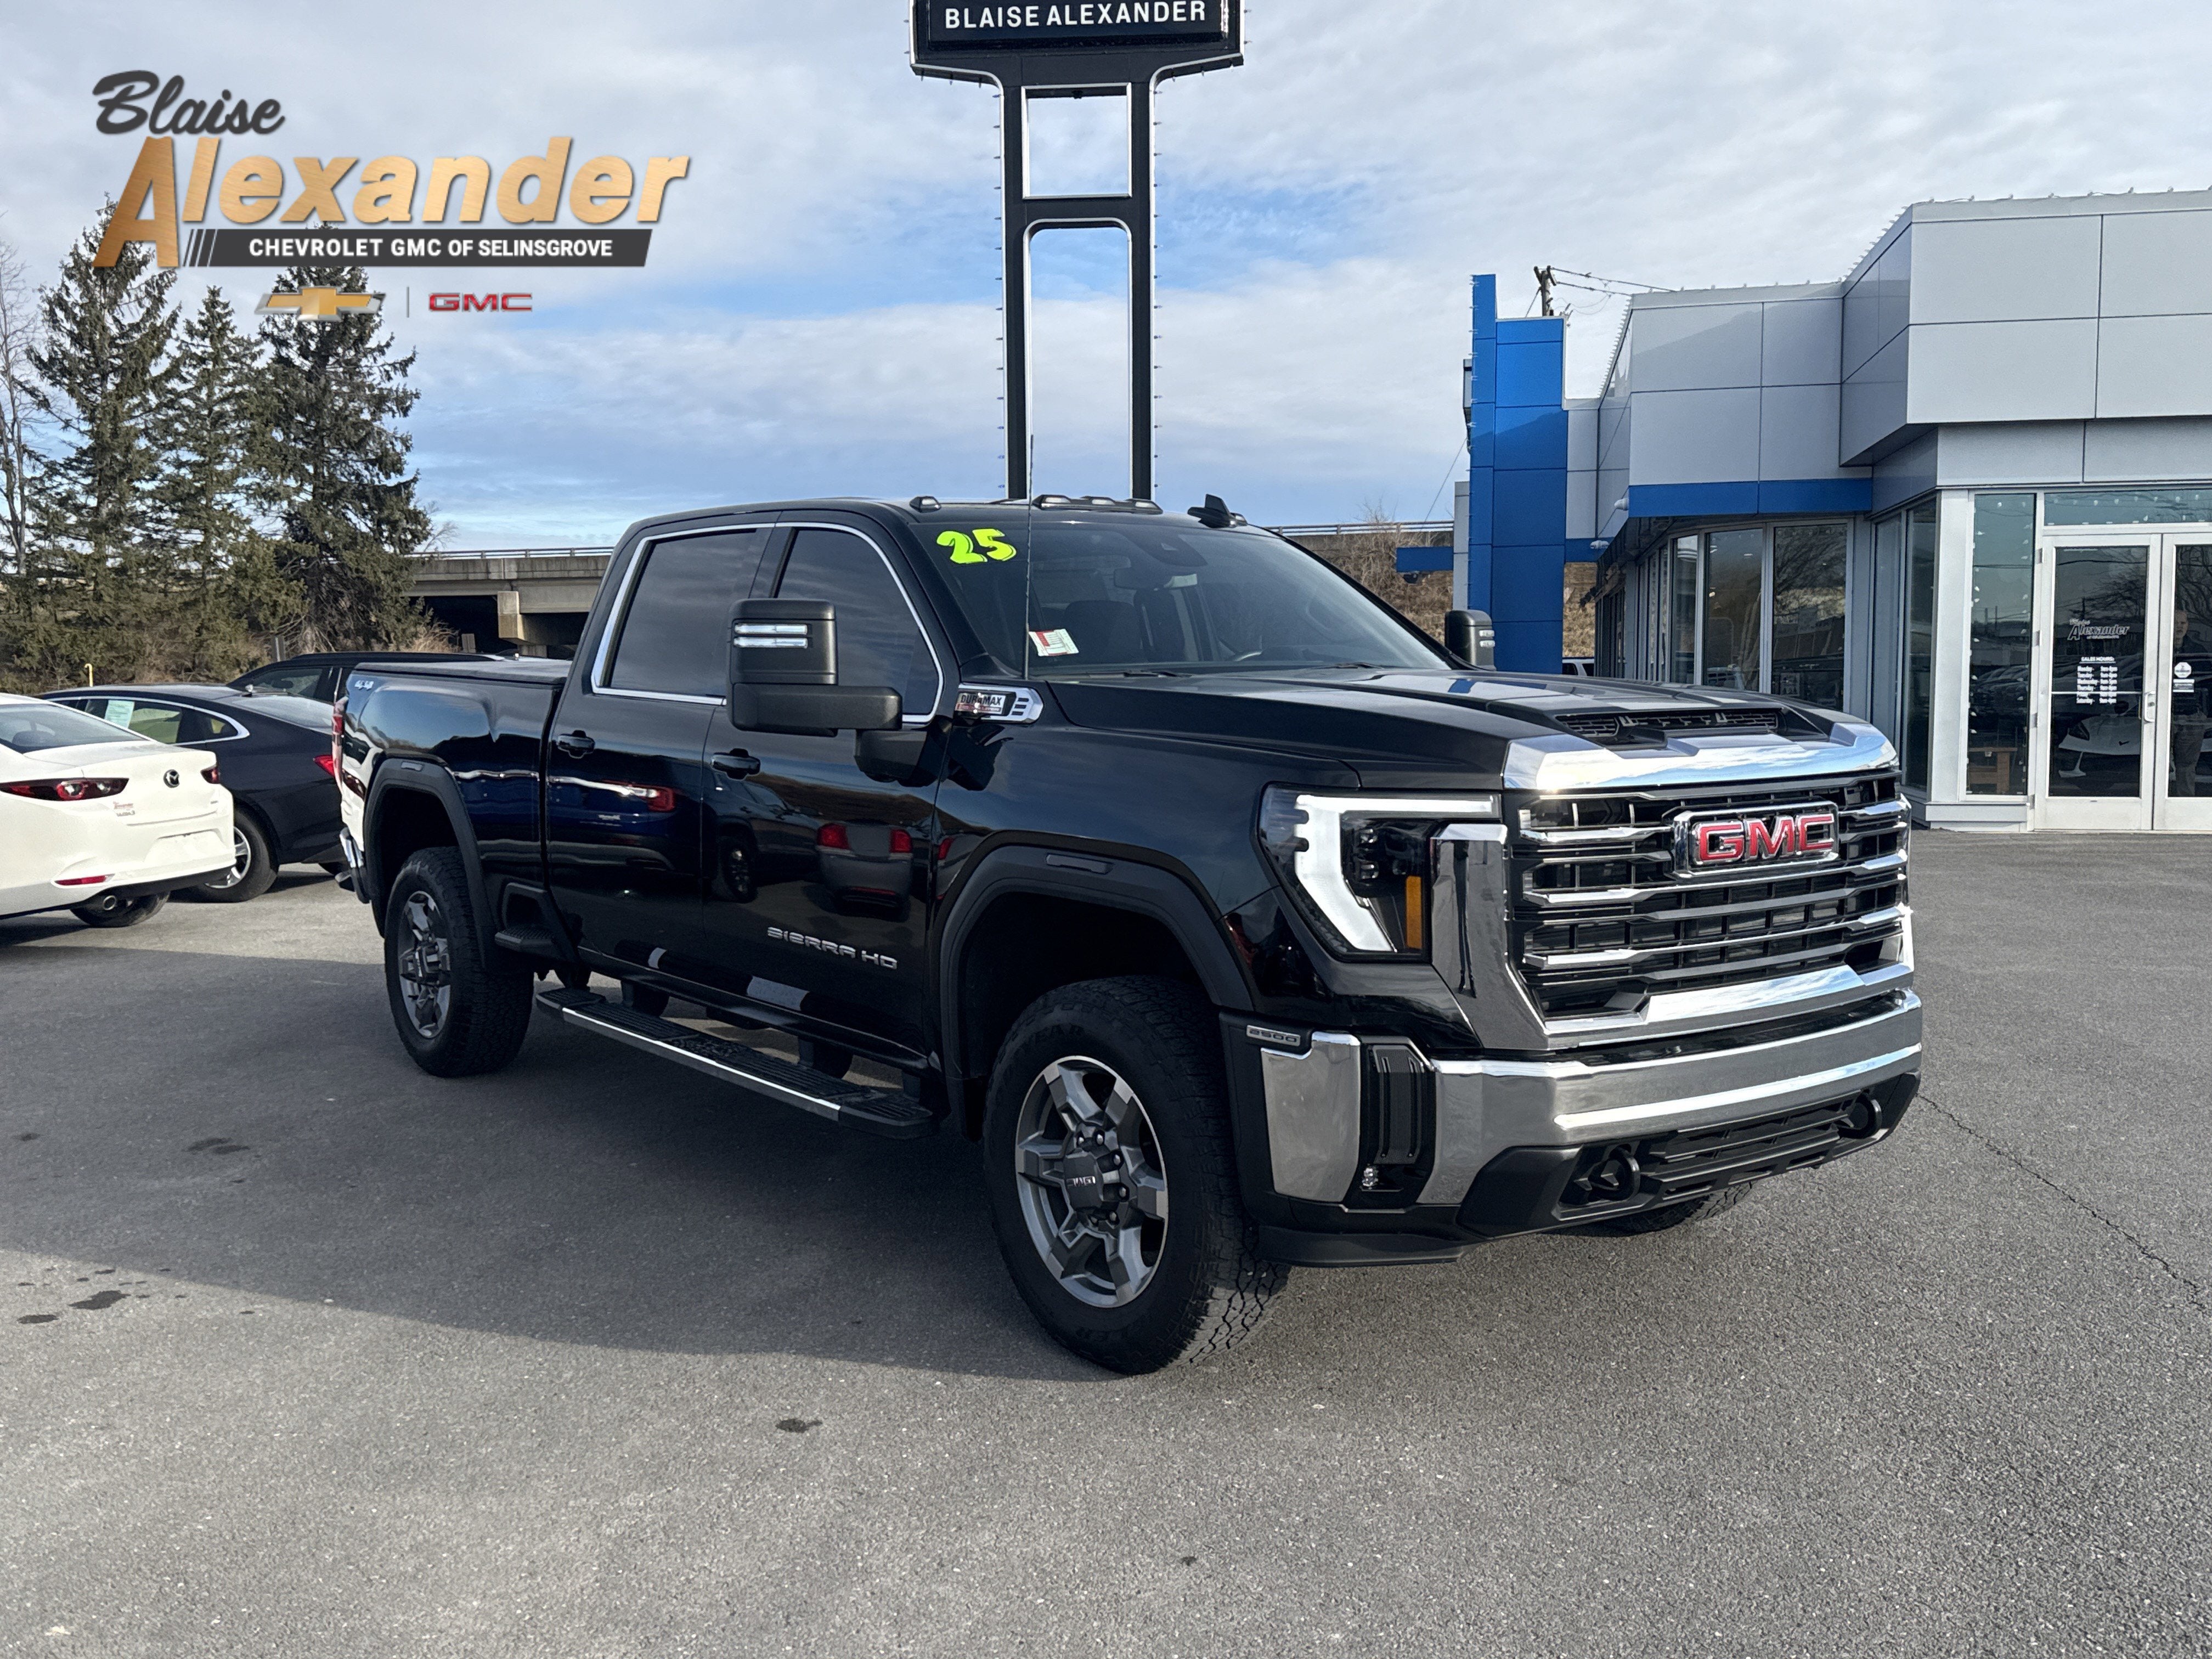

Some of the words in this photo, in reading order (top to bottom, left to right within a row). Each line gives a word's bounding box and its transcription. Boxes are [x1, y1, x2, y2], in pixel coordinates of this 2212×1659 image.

[945, 6, 1040, 29] BLAISE
[1046, 0, 1206, 26] ALEXANDER
[936, 529, 1017, 564] 25
[960, 693, 1002, 706] DURAMAX
[1693, 813, 1836, 864] GMC
[768, 927, 856, 959] SIERRA
[861, 950, 898, 970] HD
[1249, 1029, 1297, 1043] 2500
